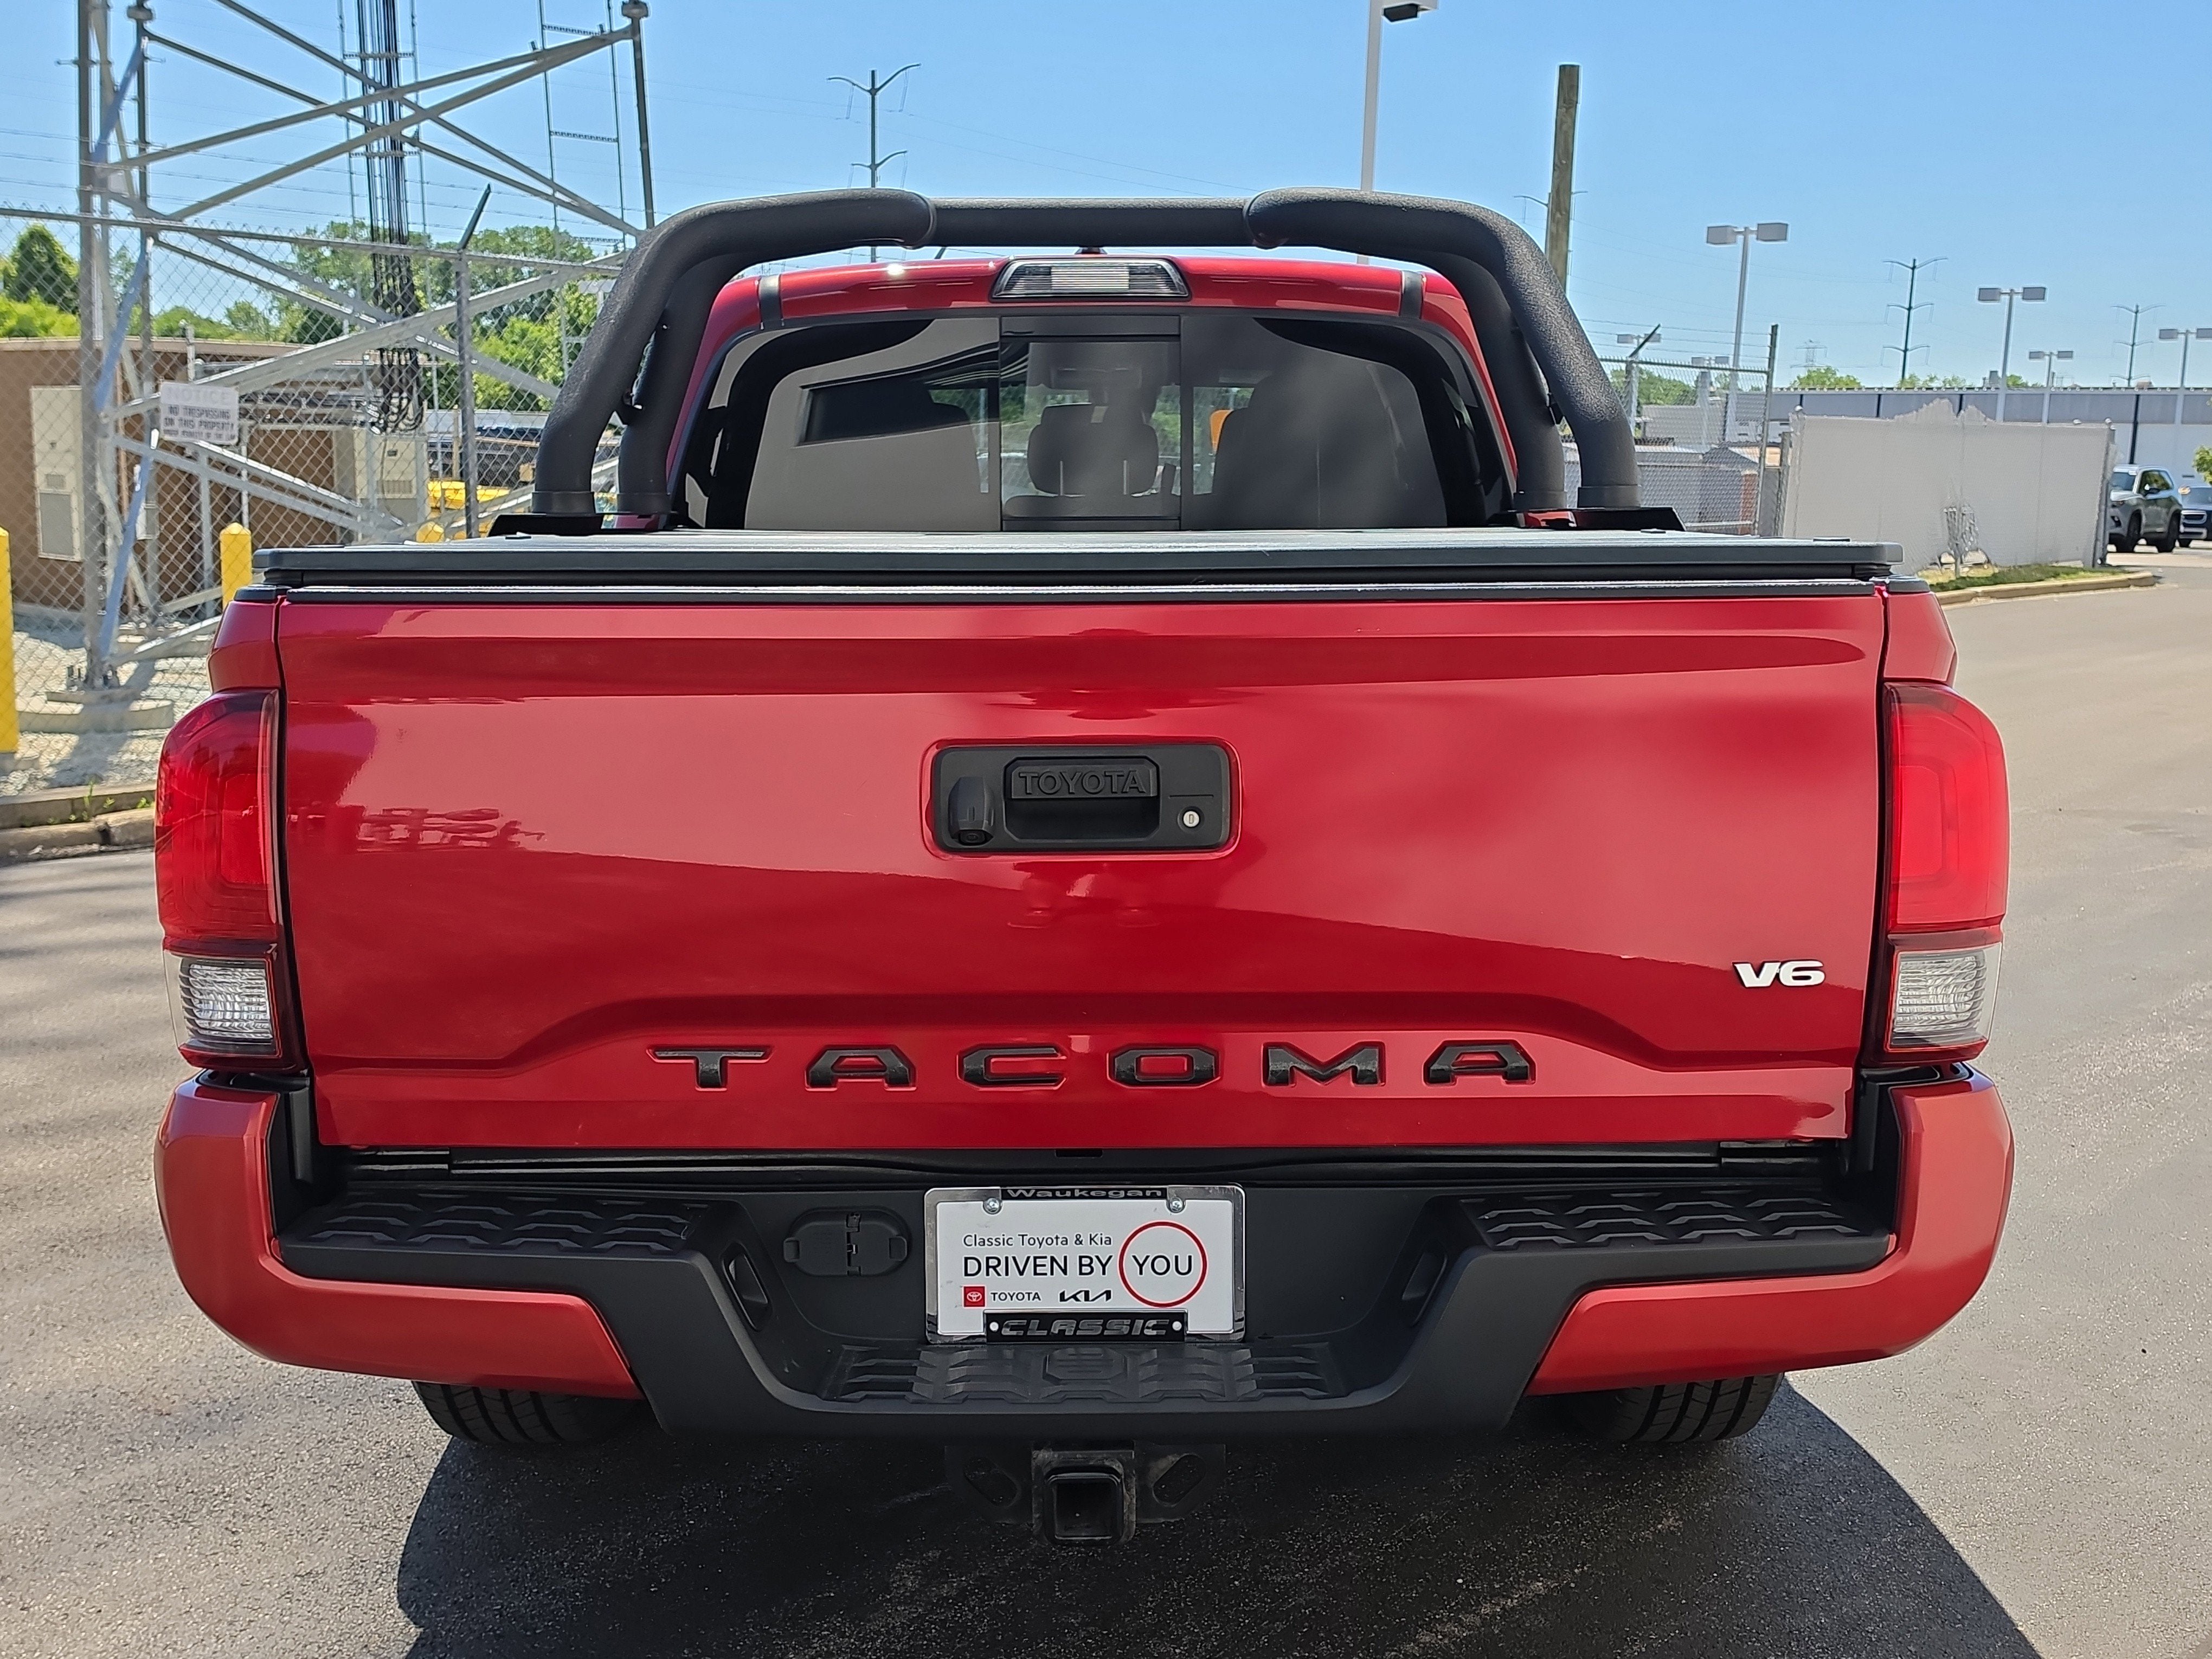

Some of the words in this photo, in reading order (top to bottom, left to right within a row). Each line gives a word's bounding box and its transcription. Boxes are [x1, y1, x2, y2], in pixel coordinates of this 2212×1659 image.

[1018, 769, 1146, 795] TOYOTA
[1733, 959, 1825, 987] V6
[648, 1040, 1535, 1089] TACOMA
[1007, 1188, 1162, 1198] Waukegan
[963, 1233, 1014, 1247] Classic
[1018, 1234, 1069, 1249] Toyota
[1073, 1234, 1084, 1246] &
[1089, 1233, 1113, 1246] Kia
[963, 1255, 1068, 1277] DRIVEN
[1078, 1255, 1113, 1276] BY
[1132, 1255, 1193, 1276] YOU
[991, 1292, 1041, 1302] TOYOTA
[1000, 1319, 1170, 1336] CLASSIC
